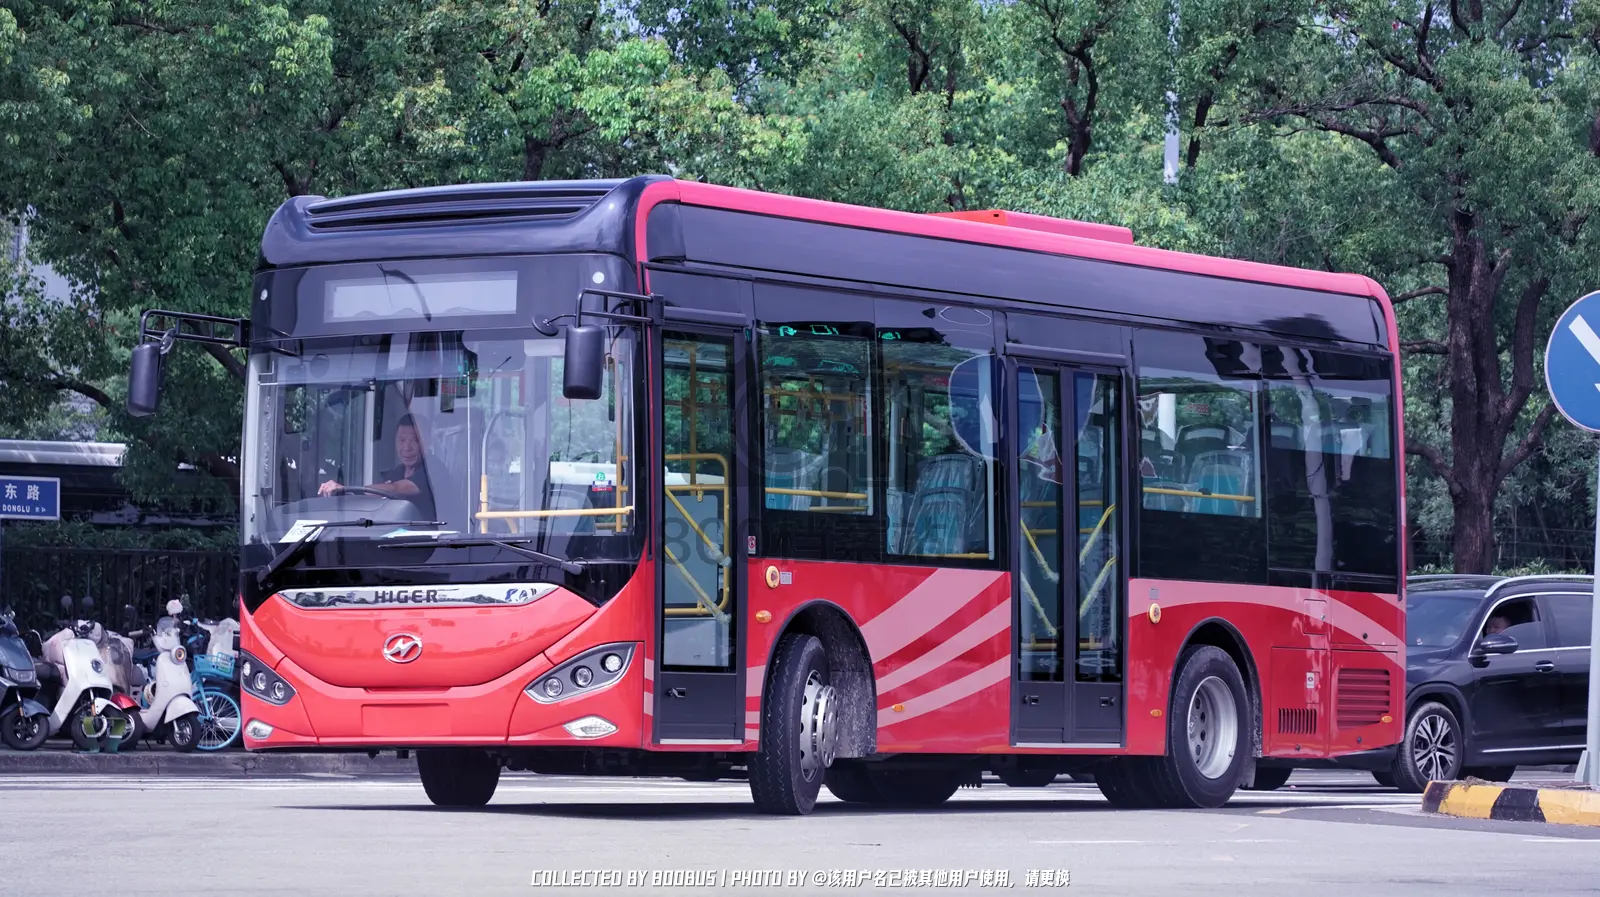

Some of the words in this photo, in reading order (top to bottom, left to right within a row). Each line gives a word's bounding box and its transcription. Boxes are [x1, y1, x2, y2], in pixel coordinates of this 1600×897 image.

[5, 483, 40, 500] 东路
[2, 504, 31, 513] DONGLU
[375, 590, 438, 604] HIGER
